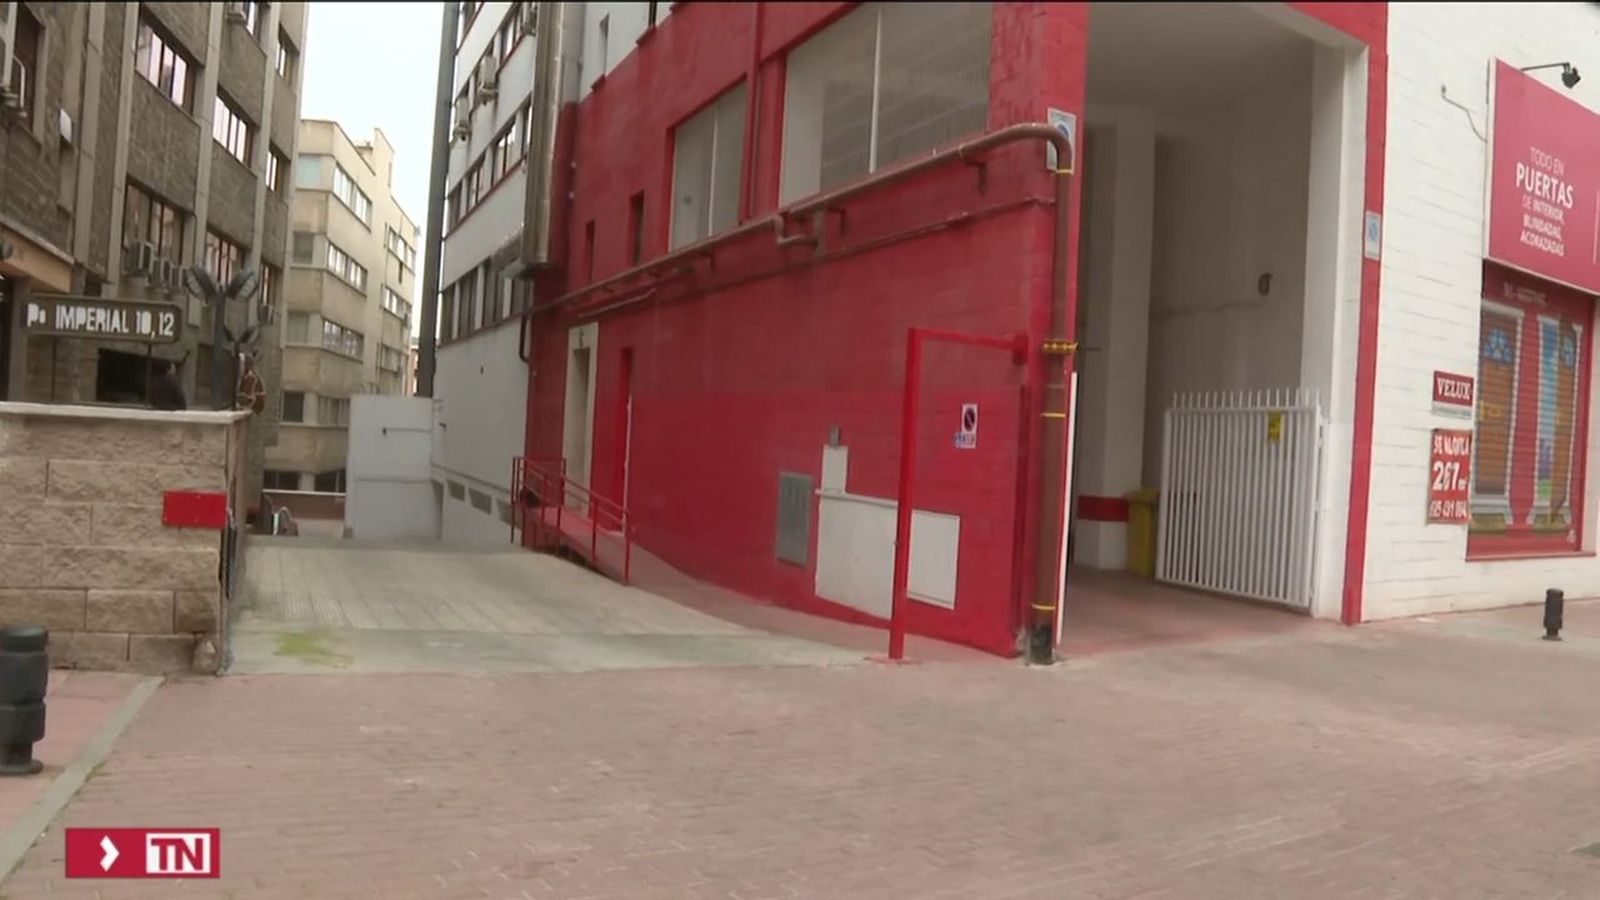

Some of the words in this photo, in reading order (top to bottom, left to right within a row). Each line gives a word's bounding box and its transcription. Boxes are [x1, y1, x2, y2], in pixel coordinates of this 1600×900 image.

[1530, 146, 1552, 170] TODO
[1516, 162, 1574, 209] PUERTAS
[55, 304, 129, 334] IMPERIAL
[1436, 377, 1471, 400] VELUX
